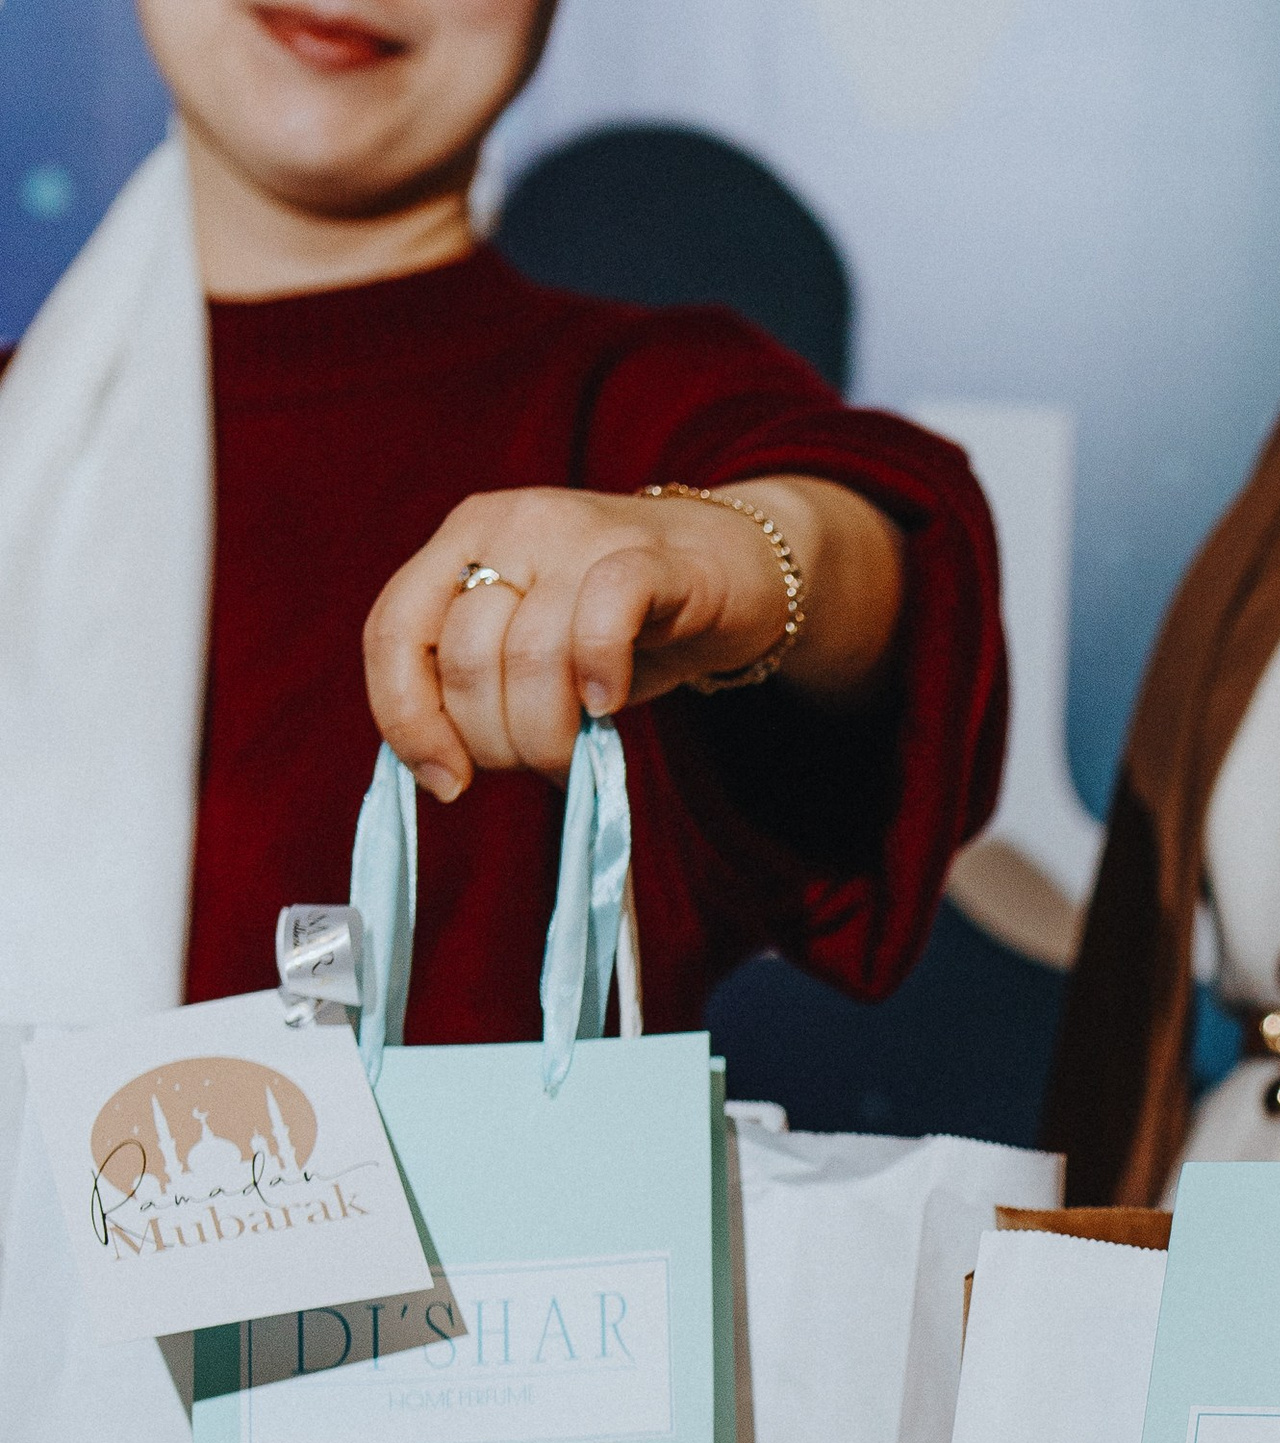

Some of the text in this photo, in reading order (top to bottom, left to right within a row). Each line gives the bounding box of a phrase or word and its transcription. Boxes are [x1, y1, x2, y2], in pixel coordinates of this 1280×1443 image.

[90, 1138, 380, 1247] Ramadan
[109, 1183, 371, 1262] Mubarak
[291, 1290, 638, 1377] DI'SHAR
